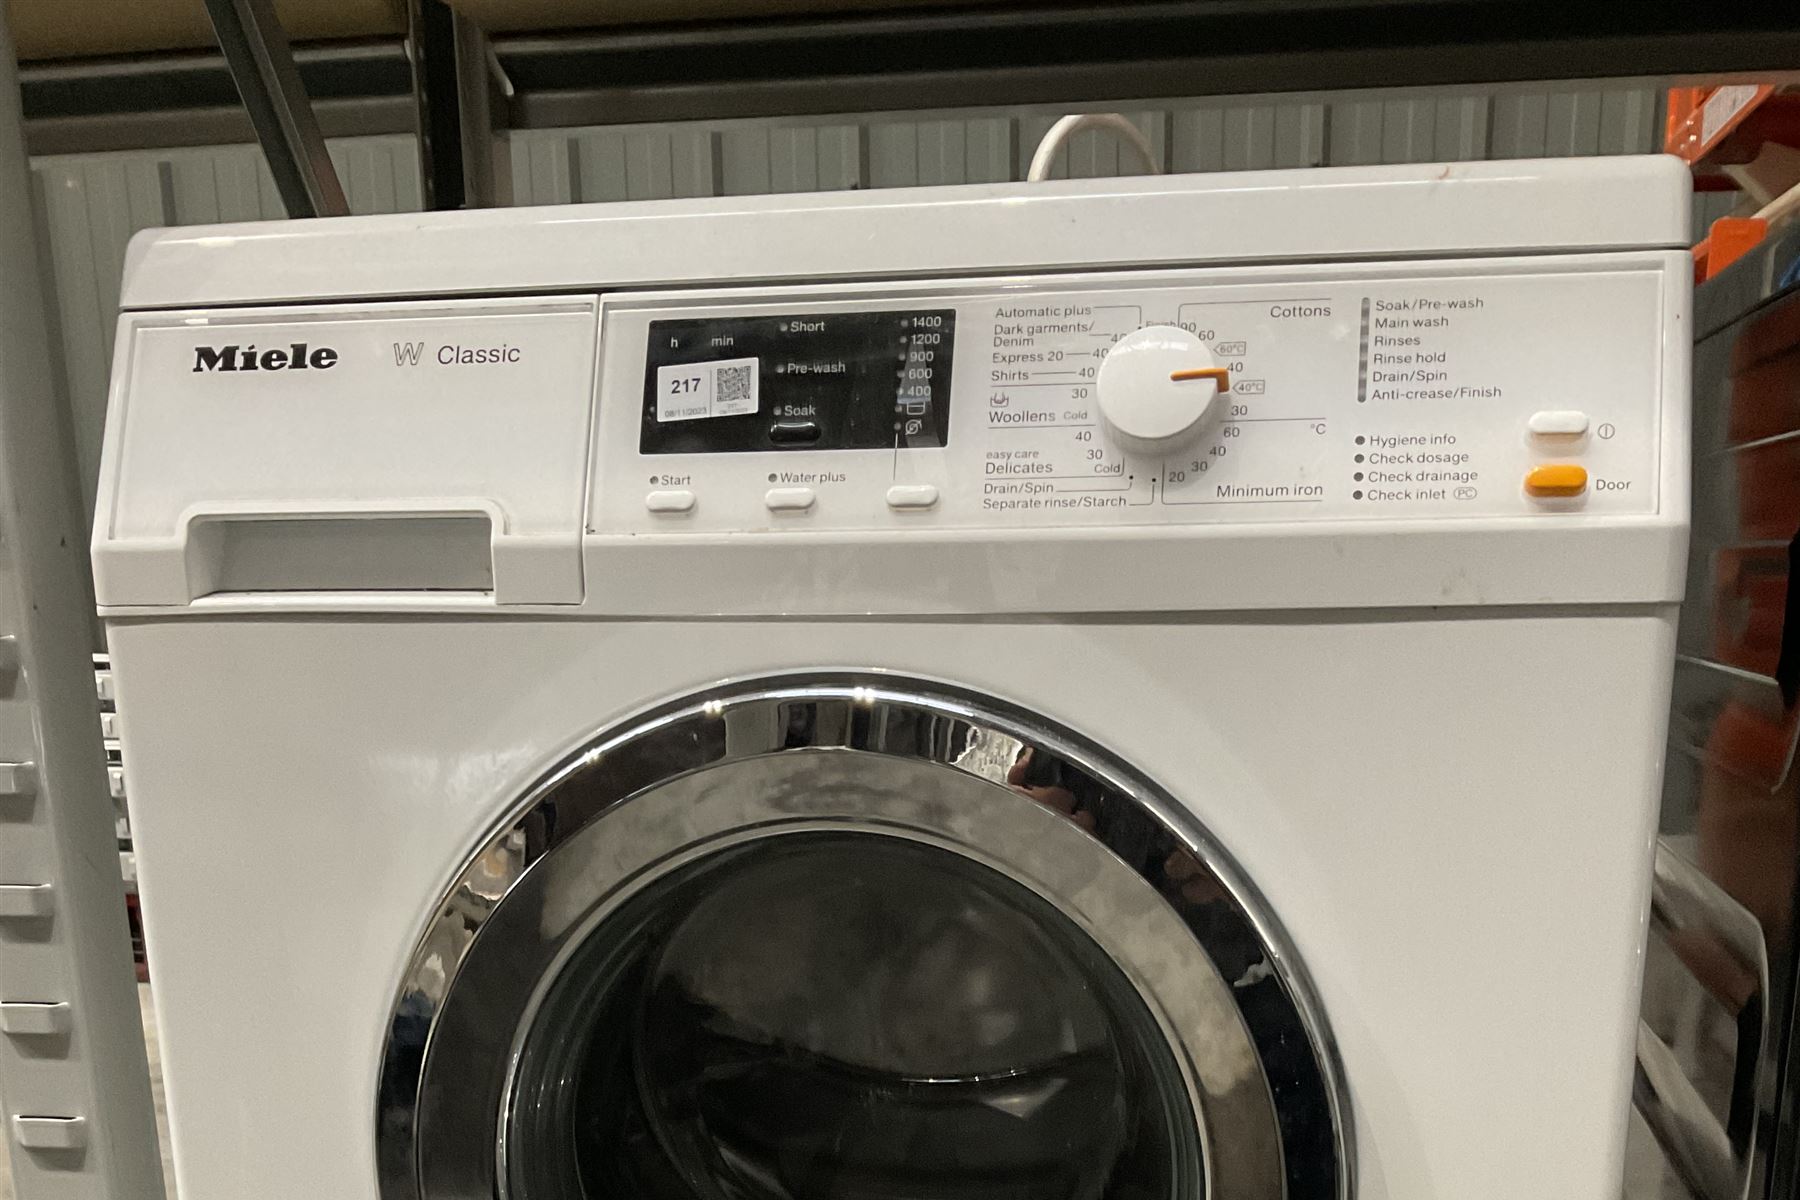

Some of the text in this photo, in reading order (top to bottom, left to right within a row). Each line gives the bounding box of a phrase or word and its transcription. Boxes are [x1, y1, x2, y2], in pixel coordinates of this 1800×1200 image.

[1375, 298, 1484, 311] Soak/Pre-wash
[995, 305, 1092, 318] Automatic plus
[1270, 305, 1331, 318] Cottons
[790, 321, 825, 333] Short
[912, 316, 941, 327] 1400
[1180, 322, 1197, 333] 90
[1375, 316, 1449, 329] Main wash
[994, 321, 1095, 336] Dark garments/
[711, 336, 734, 347] min
[911, 333, 941, 345] 1200
[1198, 330, 1215, 341] 60
[1374, 335, 1421, 347] Rinses
[671, 337, 678, 348] h
[993, 337, 1034, 347] Denim
[193, 343, 338, 372] Miele
[393, 342, 521, 366] W Classic
[910, 351, 934, 362] 900
[992, 351, 1064, 364] Express 20
[1092, 348, 1109, 359] 40
[1373, 352, 1446, 365] Rinse hold
[787, 361, 846, 374] Pre-wash
[908, 368, 933, 379] 600
[1078, 367, 1095, 378] 40
[1228, 362, 1244, 373] 40
[991, 370, 1029, 381] Shirts
[1373, 370, 1447, 383] Drain/Spin
[671, 378, 701, 394] 217
[907, 385, 931, 396] 400
[1071, 388, 1088, 399] 30
[1372, 386, 1502, 400] Anti-crease/Finish
[784, 405, 816, 417] Soak
[989, 410, 1088, 423] Woollens Cold
[1231, 405, 1248, 416] 30
[1075, 431, 1092, 442] 40
[1223, 427, 1240, 438] 60
[1370, 433, 1456, 448] Hygiene info
[986, 450, 1039, 461] easy care
[1086, 449, 1103, 460] 30
[1209, 446, 1226, 456] 40
[1369, 452, 1469, 465] Check dosage
[985, 462, 1053, 475] Delicates
[1094, 463, 1121, 474] Cold
[1191, 461, 1208, 472] 30
[661, 475, 691, 486] Start
[780, 471, 846, 484] Water plus
[1169, 472, 1185, 482] 20
[1368, 471, 1478, 483] Check drainage
[984, 482, 1054, 498] Drain/Spin
[1216, 484, 1322, 498] Minimum iron
[1596, 479, 1631, 491] Door
[1367, 488, 1474, 501] Check inlet PC
[983, 496, 1127, 511] Separate rinse/Starch
